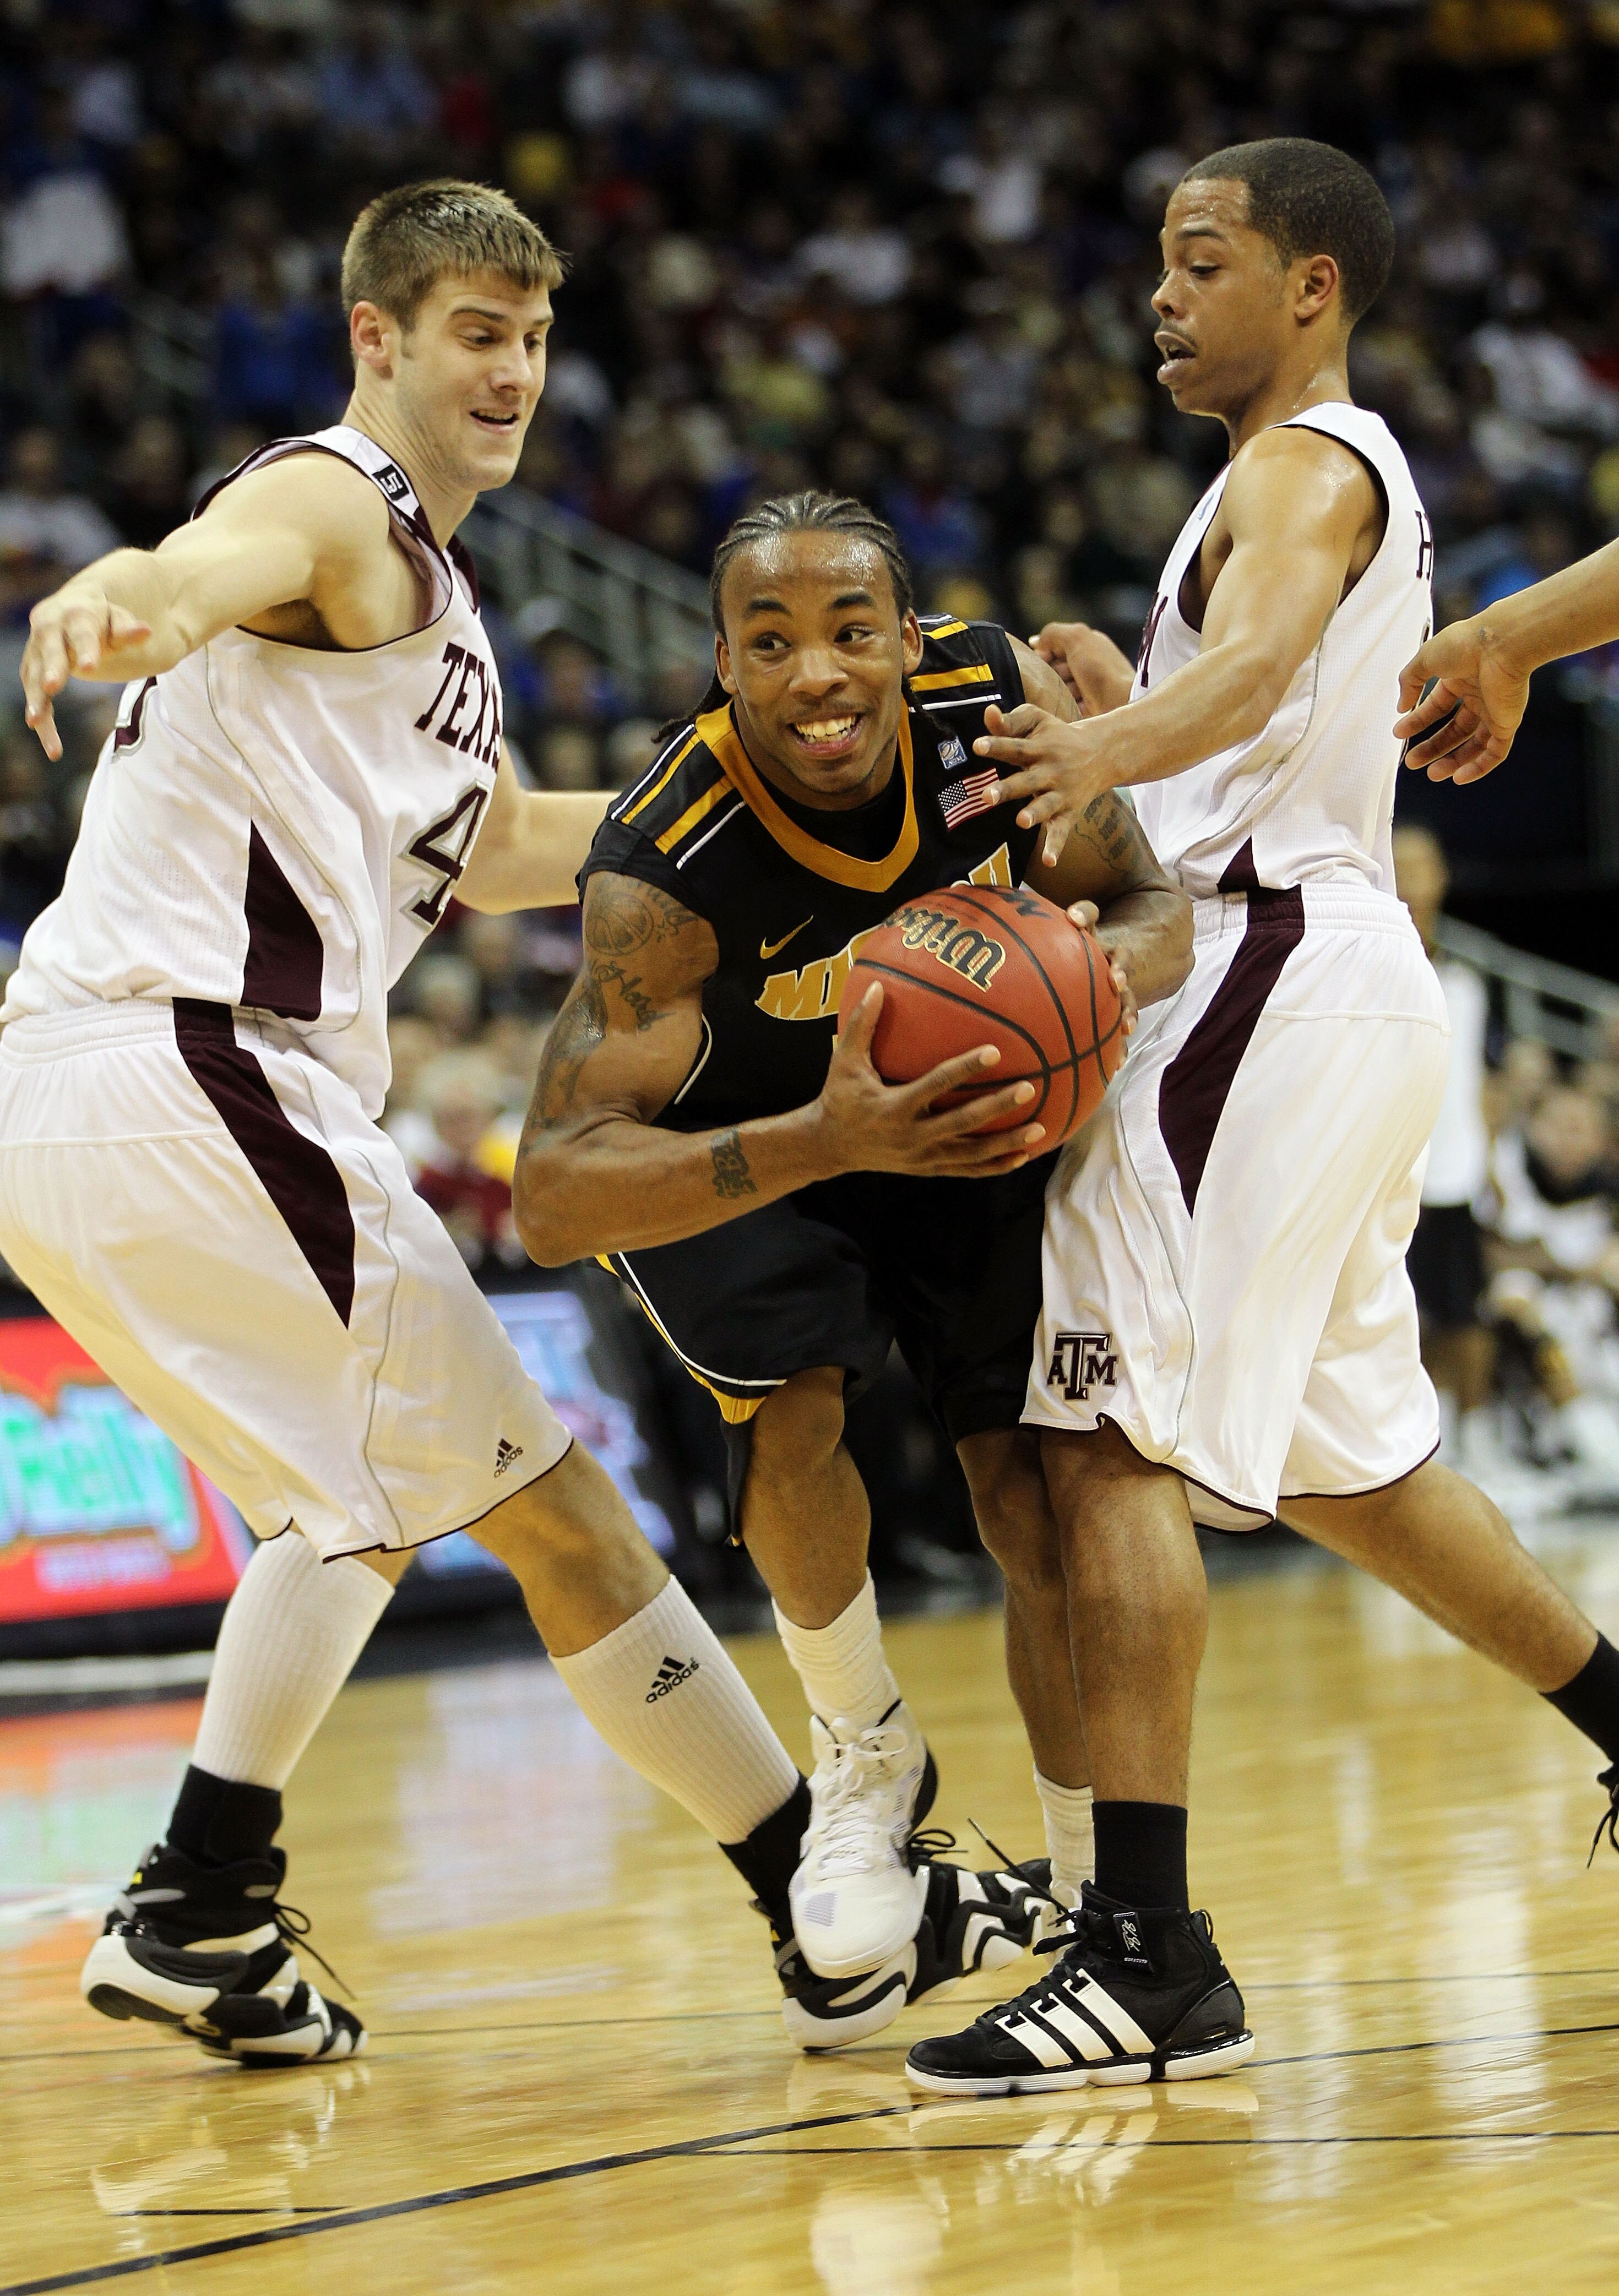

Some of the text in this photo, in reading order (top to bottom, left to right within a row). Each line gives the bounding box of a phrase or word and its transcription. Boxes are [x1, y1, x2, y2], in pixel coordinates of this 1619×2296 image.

[1415, 509, 1434, 581] H
[883, 906, 1007, 993] Wils
[494, 1446, 523, 1478] adidas
[646, 1660, 699, 1704] adidas
